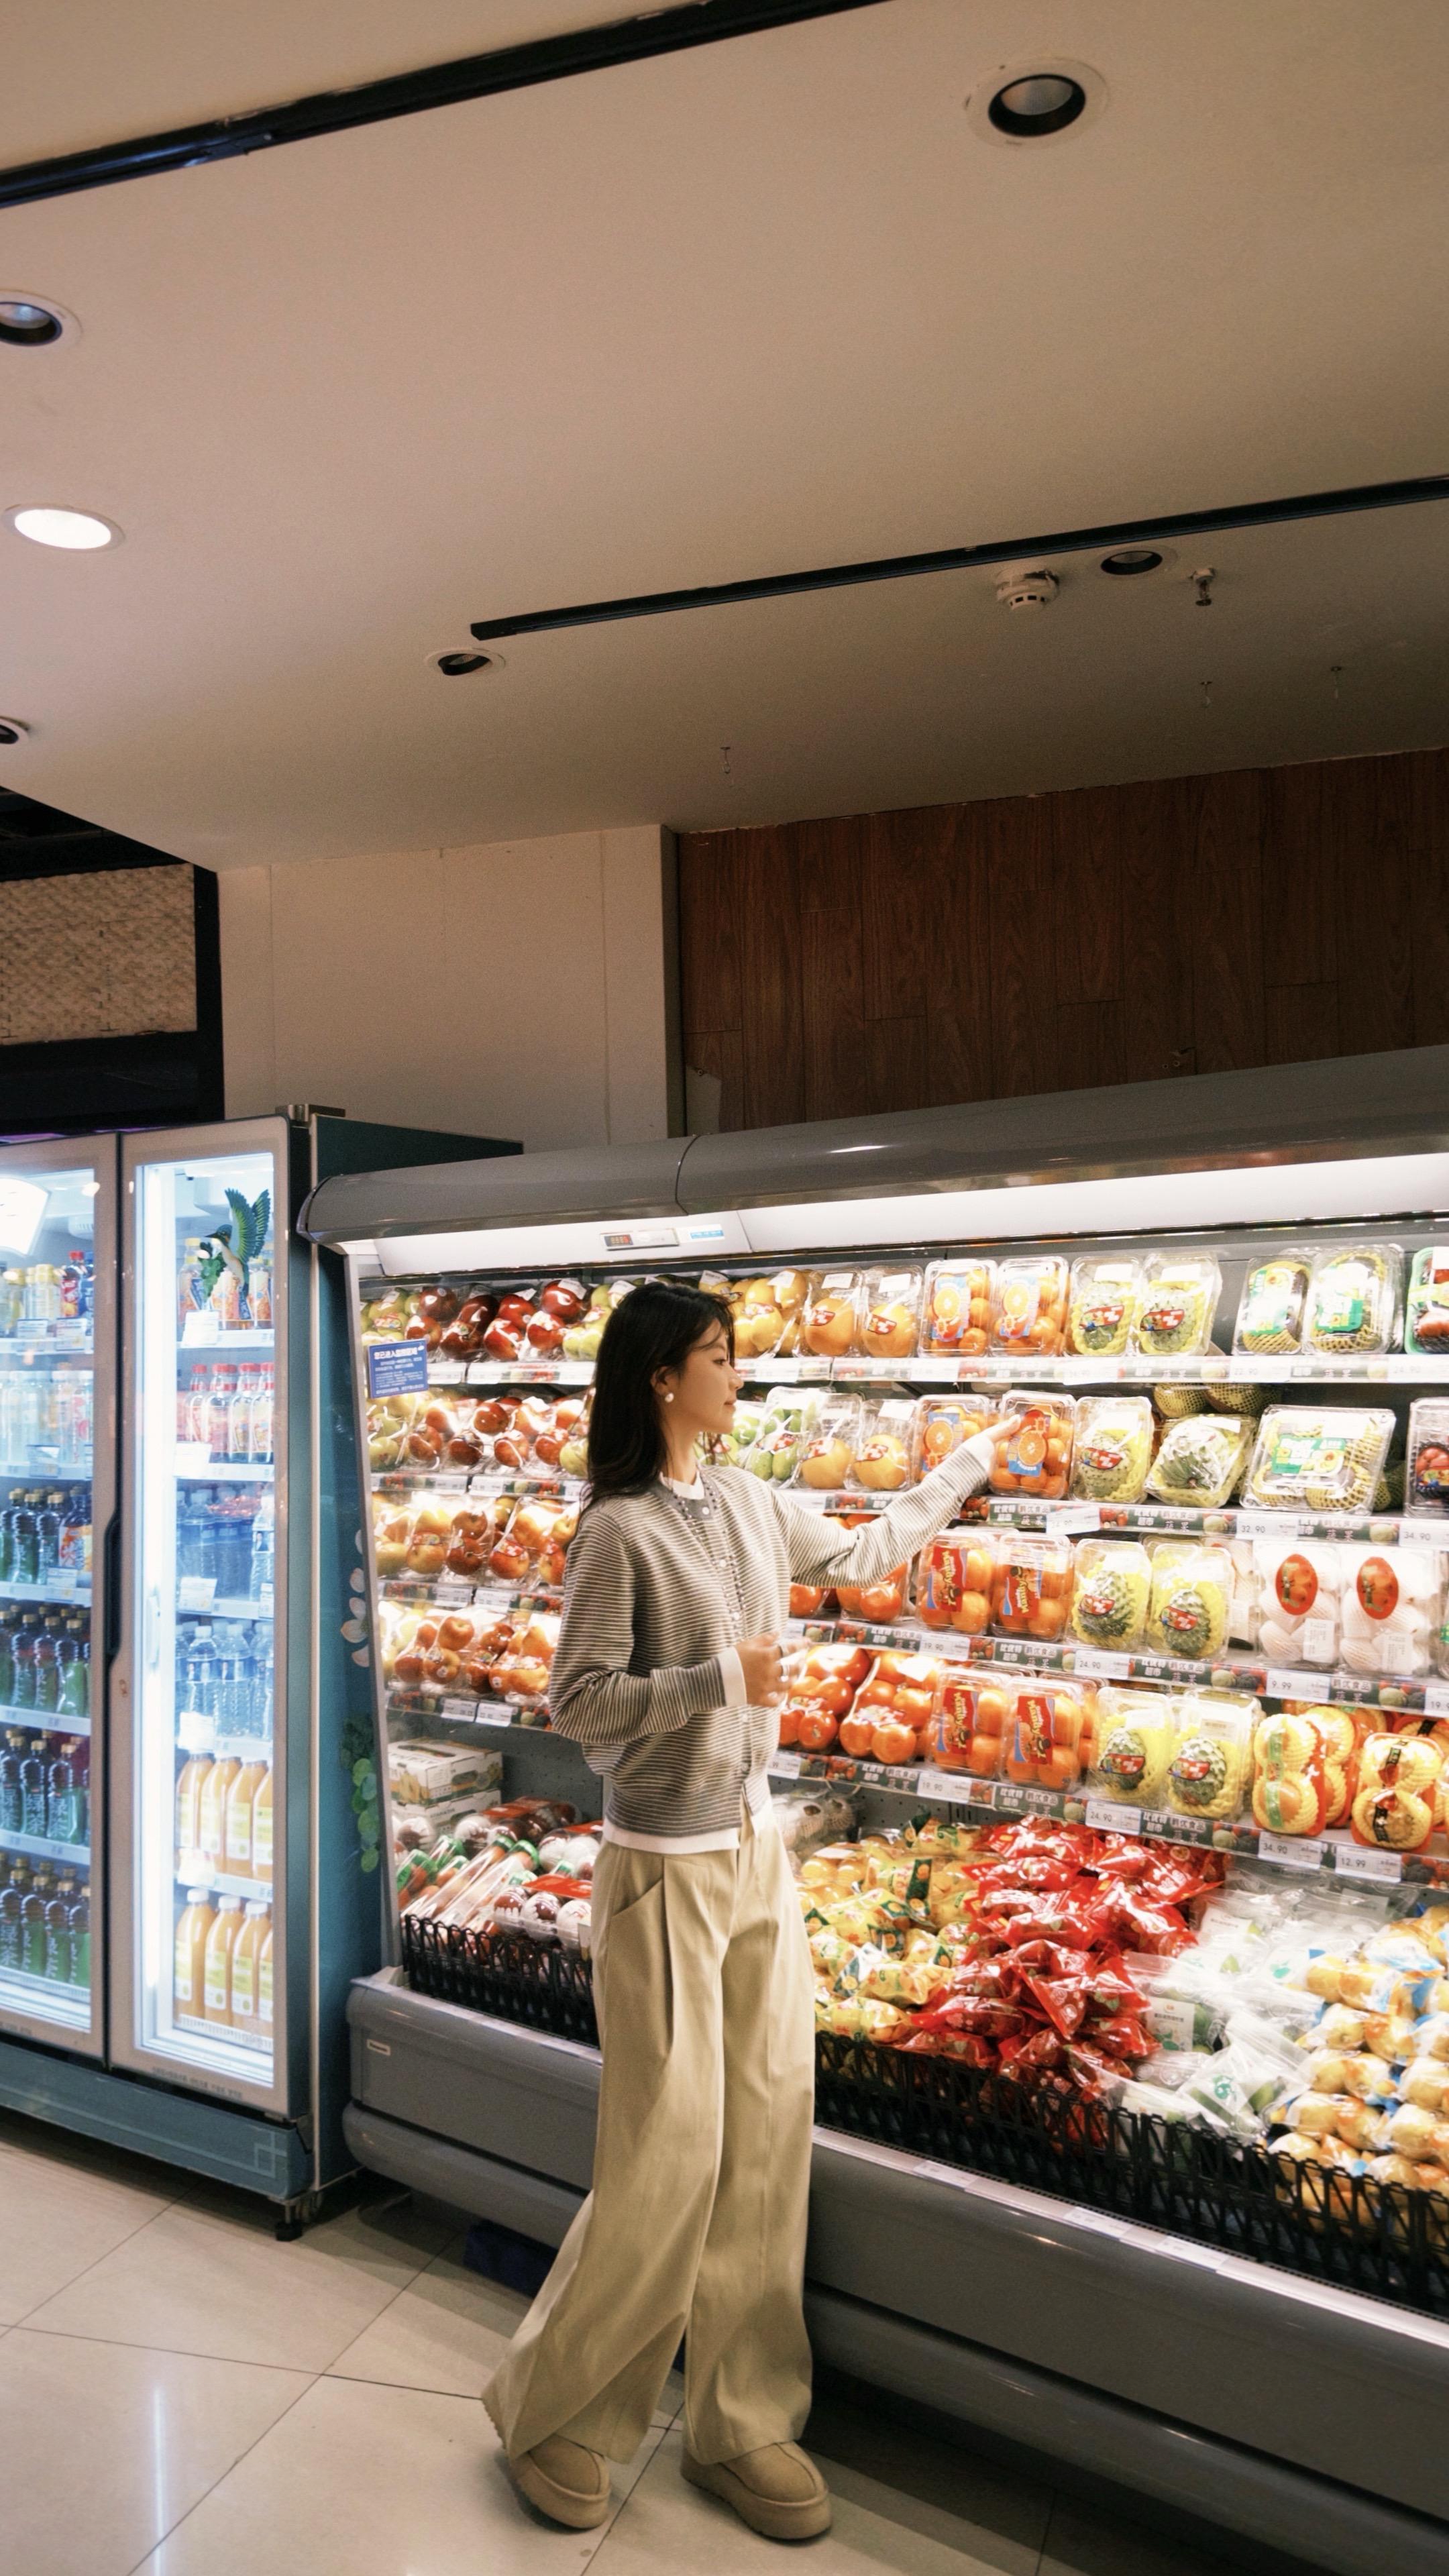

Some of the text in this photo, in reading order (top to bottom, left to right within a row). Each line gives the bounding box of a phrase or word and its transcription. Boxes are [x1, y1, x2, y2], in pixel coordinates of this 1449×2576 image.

[1079, 1660, 1101, 1670] 24.90
[1271, 1680, 1292, 1690] 9.99
[26, 1792, 45, 1833] 绿茶
[1090, 1811, 1113, 1823] 24.90
[1263, 1843, 1288, 1855] 34.90
[1341, 1858, 1366, 1869] 12.99
